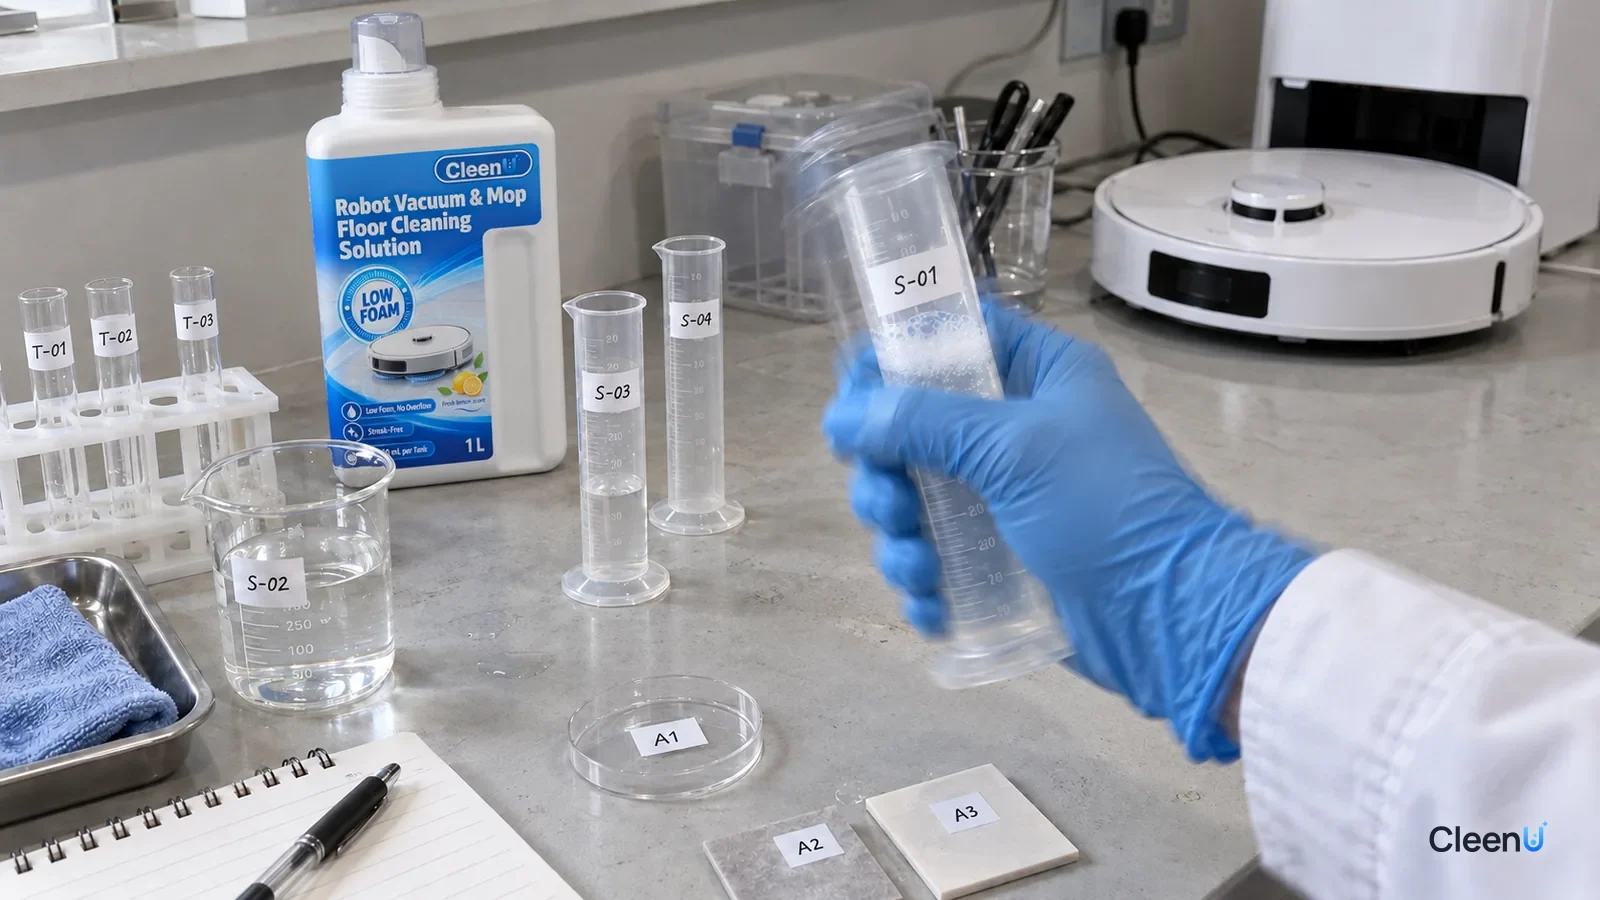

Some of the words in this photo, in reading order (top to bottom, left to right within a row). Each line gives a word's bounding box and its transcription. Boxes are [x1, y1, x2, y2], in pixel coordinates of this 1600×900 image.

[445, 157, 518, 180] CleenU
[335, 197, 391, 217] Robot
[393, 191, 466, 211] Vacuum
[469, 188, 484, 207] &
[486, 187, 527, 207] Mop
[337, 217, 388, 238] Floor
[391, 211, 472, 234] Cleaning
[339, 238, 422, 260] Solution
[894, 265, 937, 295] S-01
[362, 287, 394, 308] LOW
[182, 313, 215, 330] T-03
[360, 302, 400, 325] FOAM
[680, 312, 712, 328] S-04
[98, 328, 133, 347] T-02
[32, 340, 67, 359] T-01
[595, 384, 631, 400] S-03
[396, 403, 405, 412] No
[967, 502, 985, 517] 20
[247, 574, 290, 592] S-02
[286, 619, 312, 632] 250
[287, 644, 314, 656] 100
[654, 730, 680, 748] A1
[954, 805, 980, 823] A3
[797, 838, 824, 856] A2
